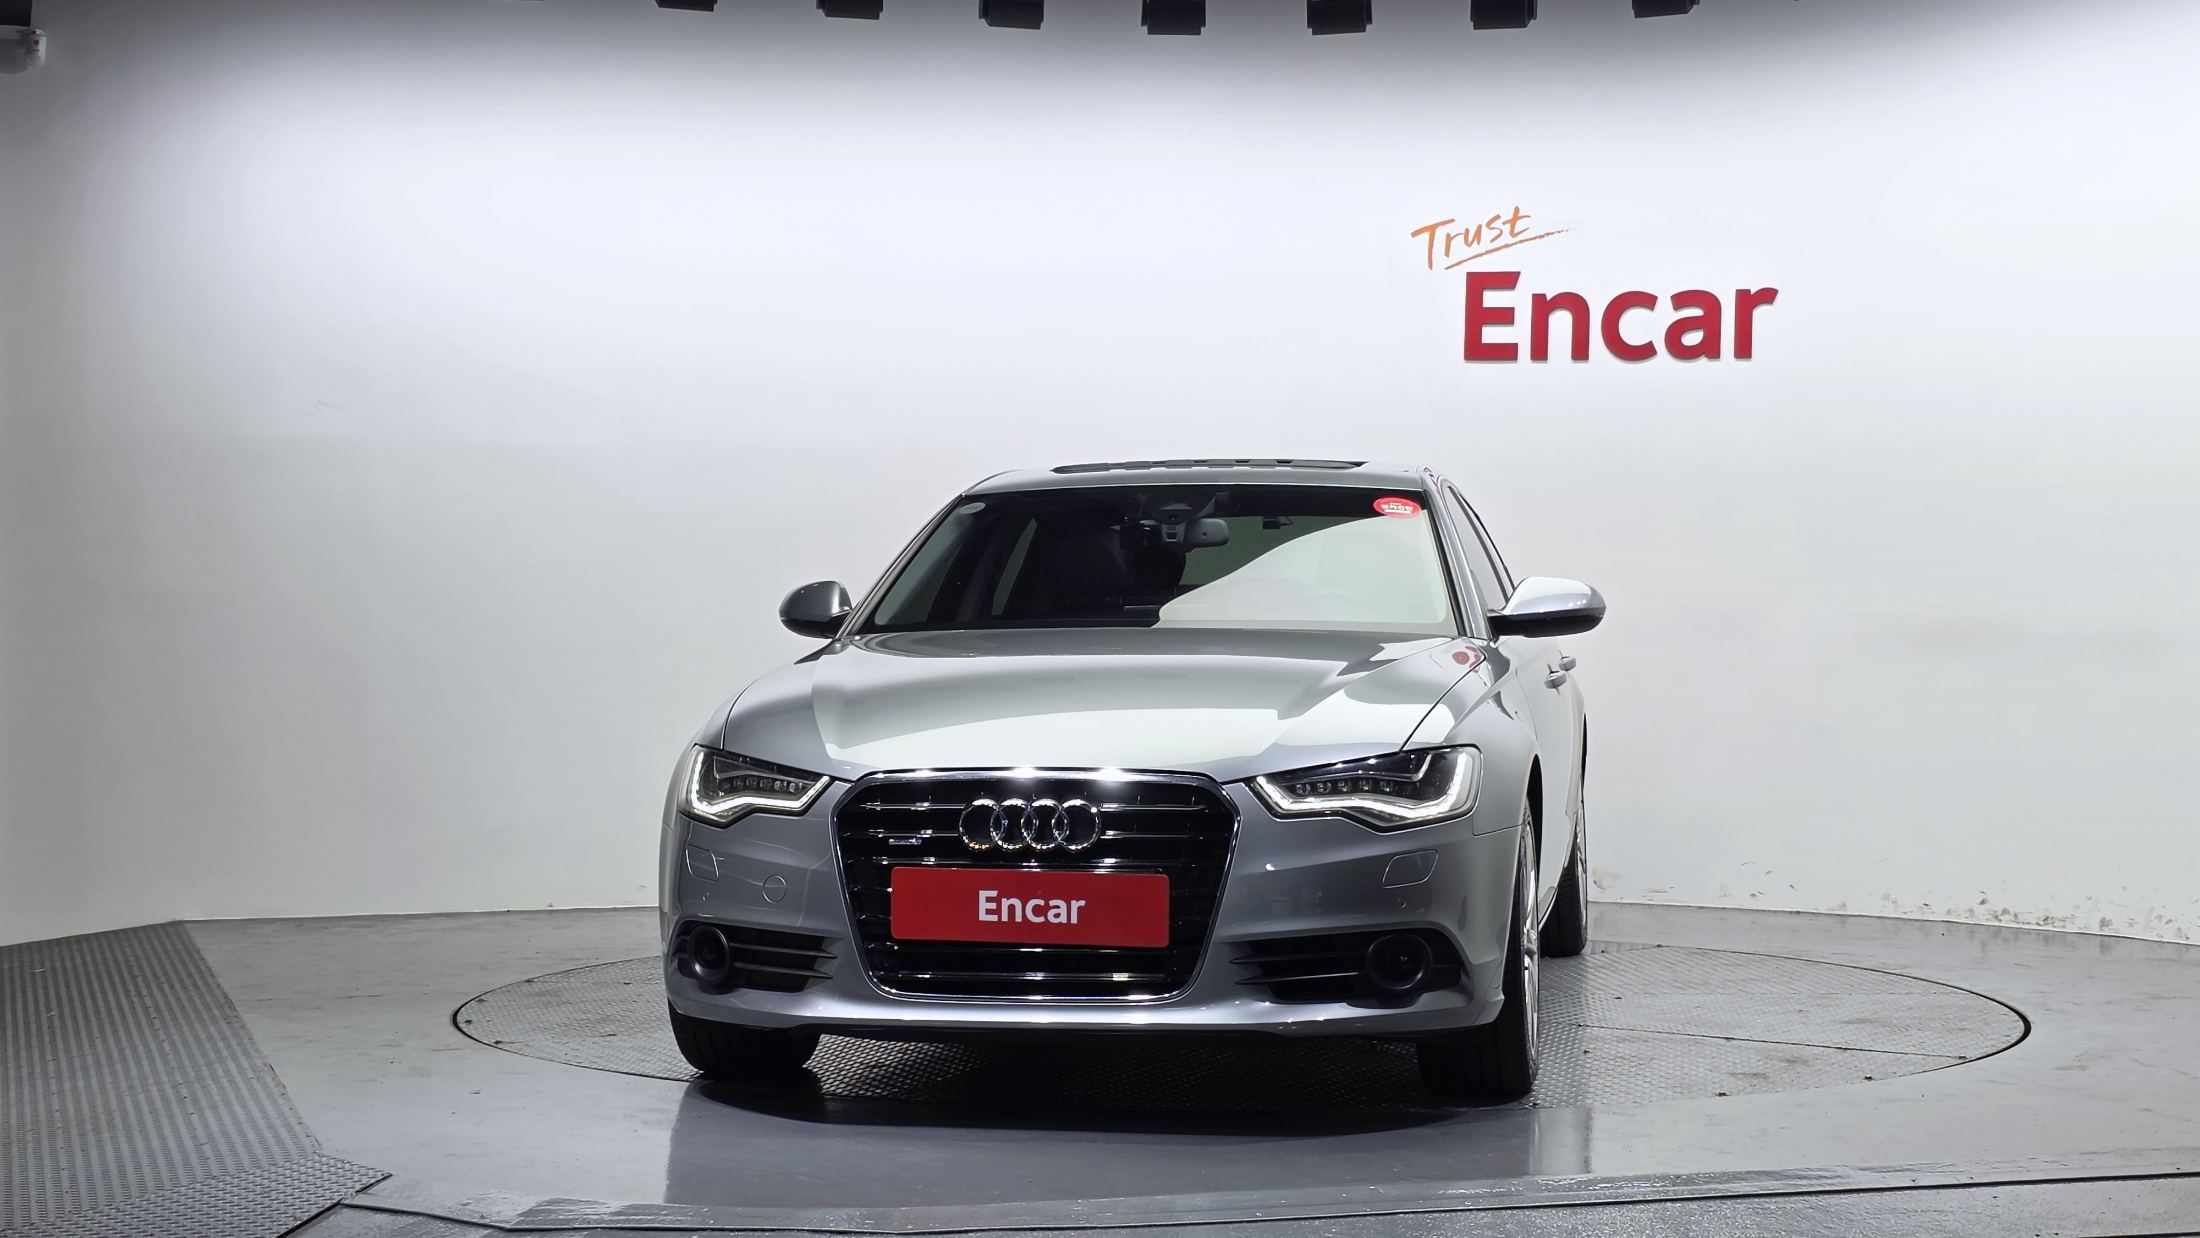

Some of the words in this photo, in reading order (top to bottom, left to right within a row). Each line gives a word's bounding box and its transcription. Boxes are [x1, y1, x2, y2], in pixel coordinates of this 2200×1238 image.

[1411, 206, 1531, 270] Trust
[1464, 271, 1779, 361] Encar
[977, 889, 1087, 925] Encar
